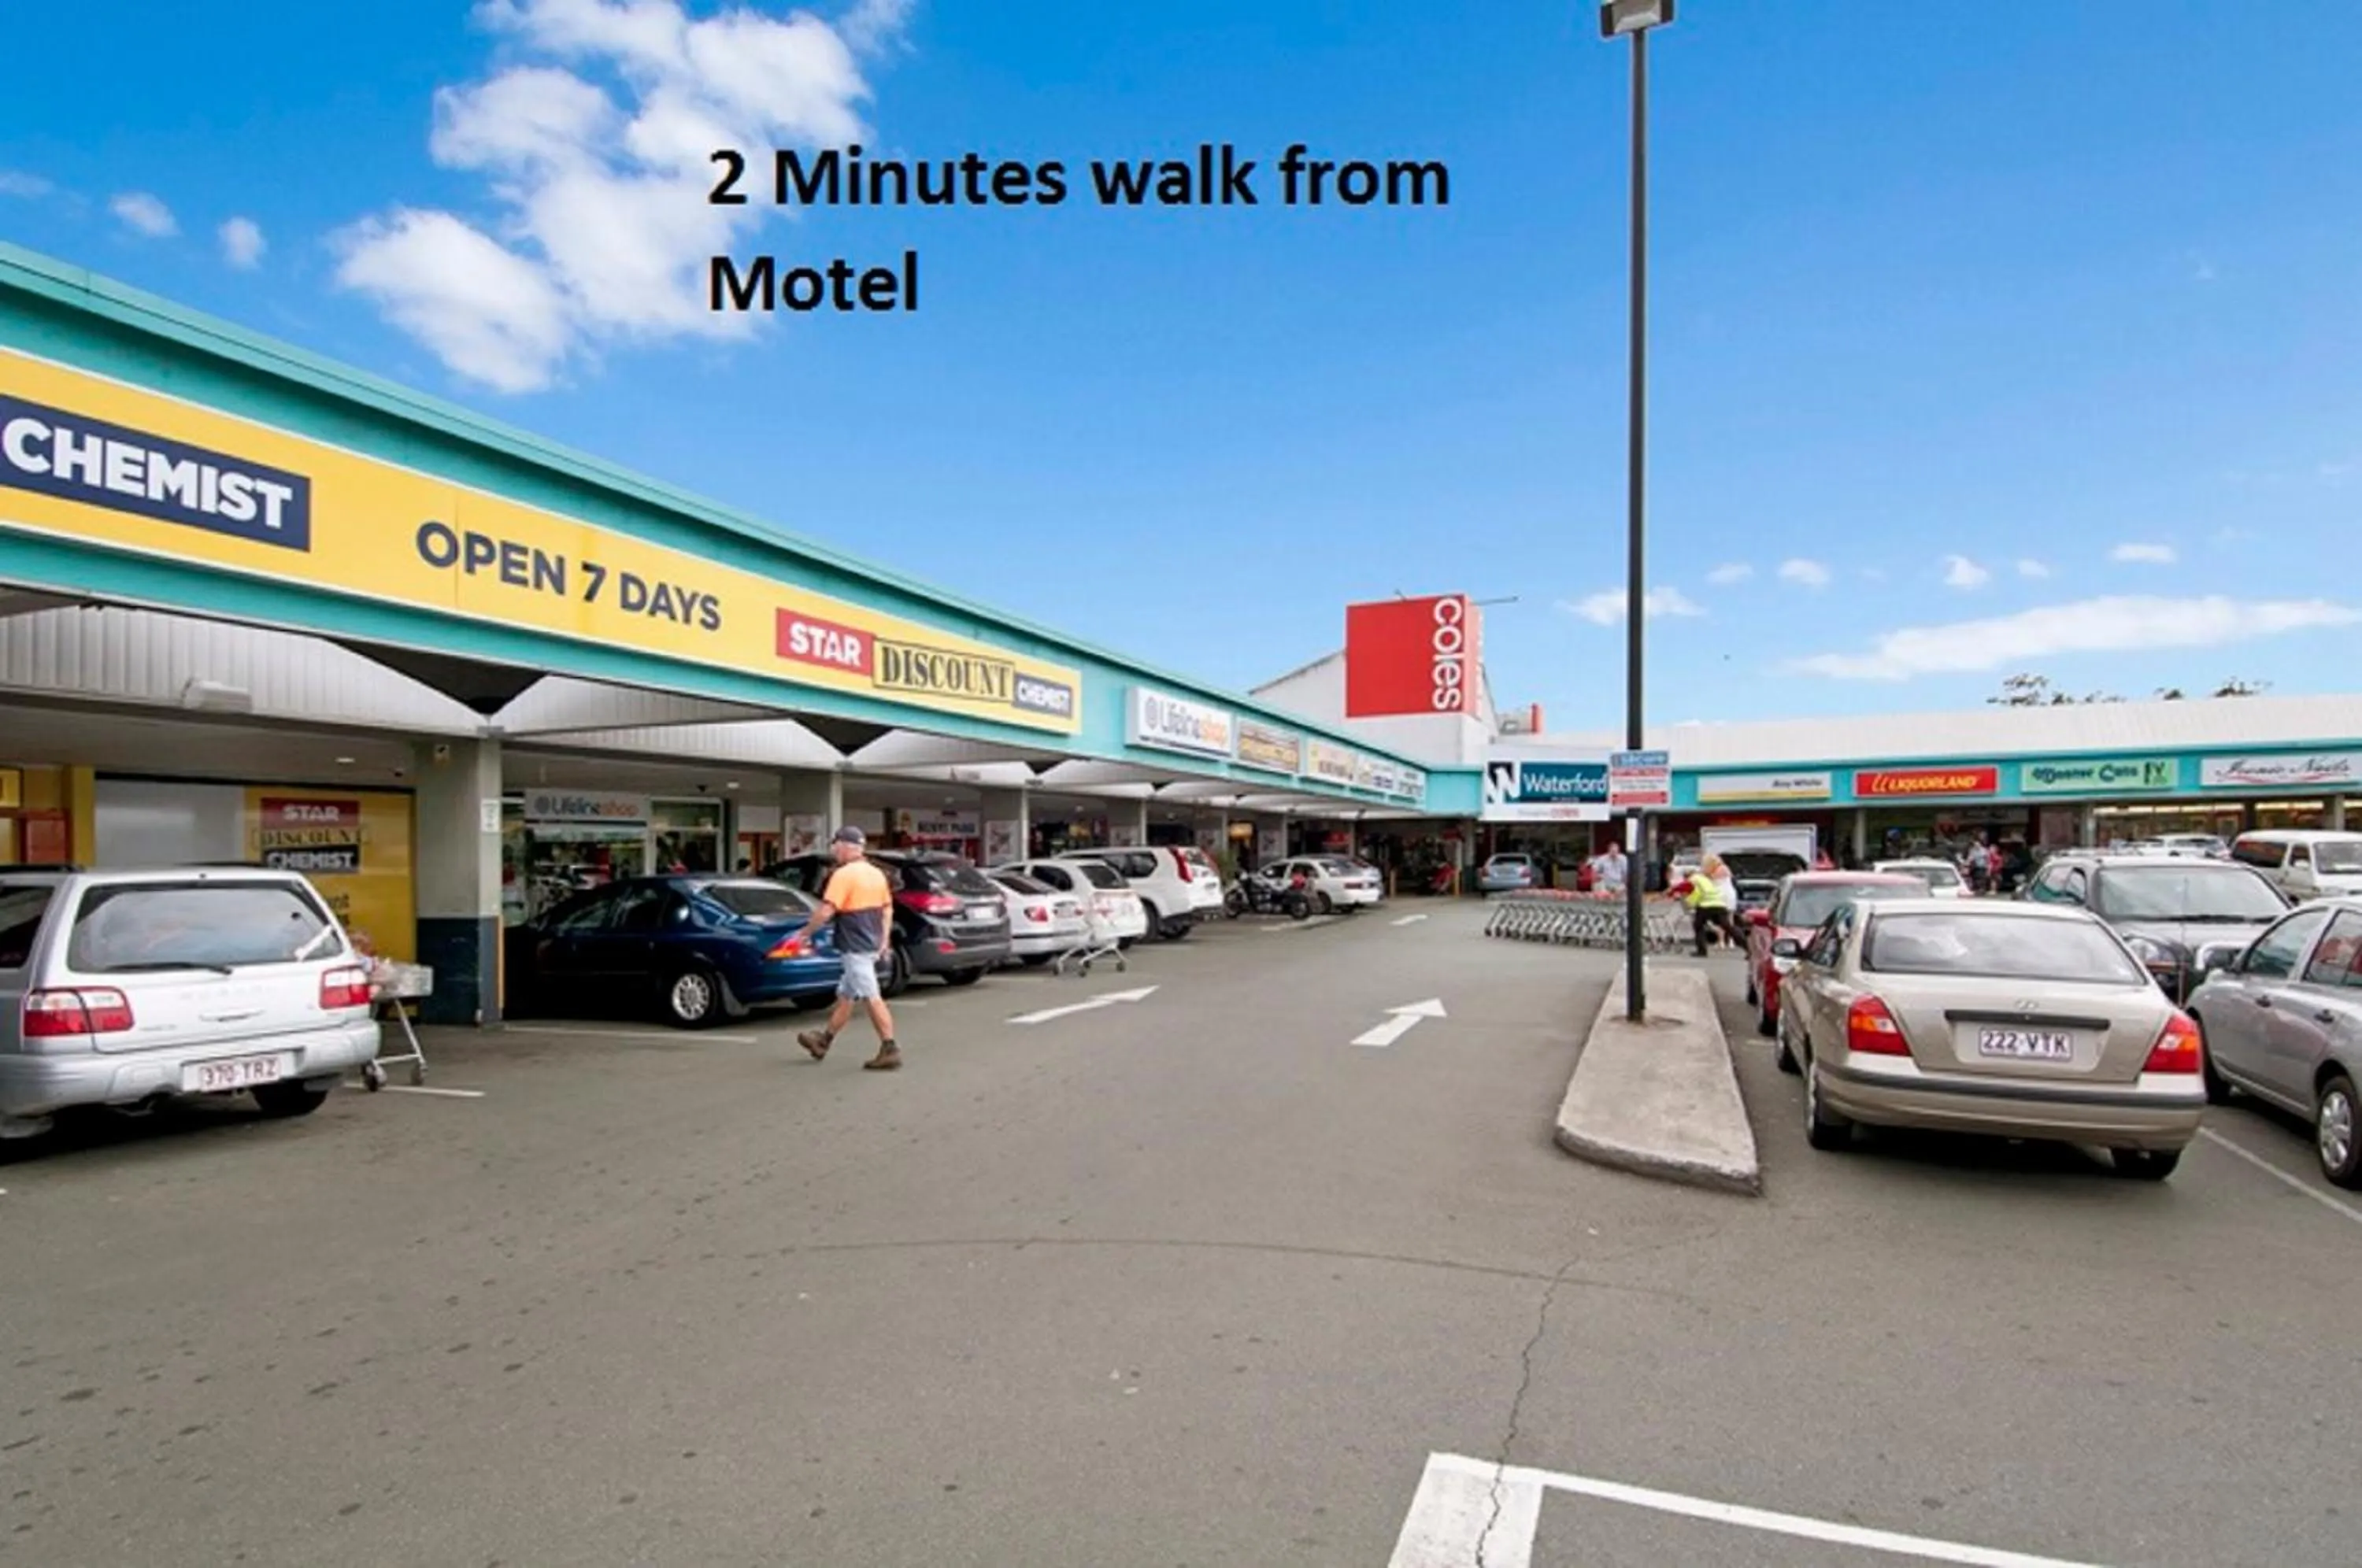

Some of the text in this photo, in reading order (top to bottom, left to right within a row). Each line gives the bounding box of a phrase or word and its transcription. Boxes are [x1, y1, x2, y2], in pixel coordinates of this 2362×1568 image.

[2, 417, 292, 530] CHEMIST
[416, 521, 721, 631] OPEN 7 DAYS
[790, 621, 861, 667] STAR
[1432, 597, 1464, 710] coles
[882, 645, 1010, 698] DISCOUNT
[1017, 680, 1070, 710] CHEMIST
[1523, 771, 1608, 795] Waterford
[283, 803, 340, 822] STAR
[267, 852, 355, 870] CHEMIST
